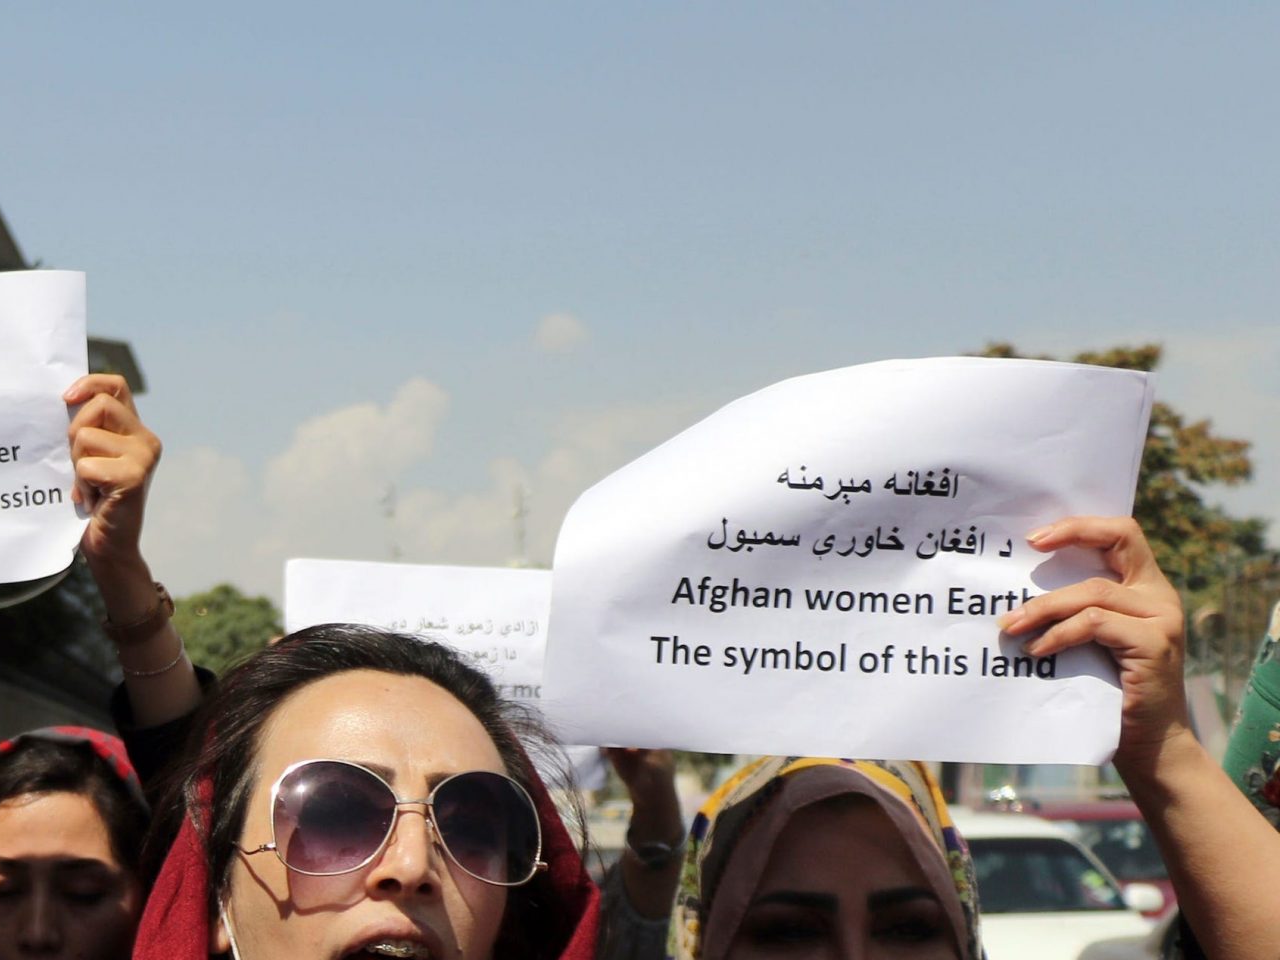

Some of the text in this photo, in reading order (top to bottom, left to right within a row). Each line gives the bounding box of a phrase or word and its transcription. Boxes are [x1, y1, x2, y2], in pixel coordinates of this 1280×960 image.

[883, 467, 960, 499] افغانه
[706, 516, 801, 553] سمبول
[915, 525, 986, 560] افغان
[998, 538, 1013, 558] د
[670, 575, 793, 614] Afghan
[804, 588, 934, 615] women
[649, 635, 1057, 679] The symbol of this land
